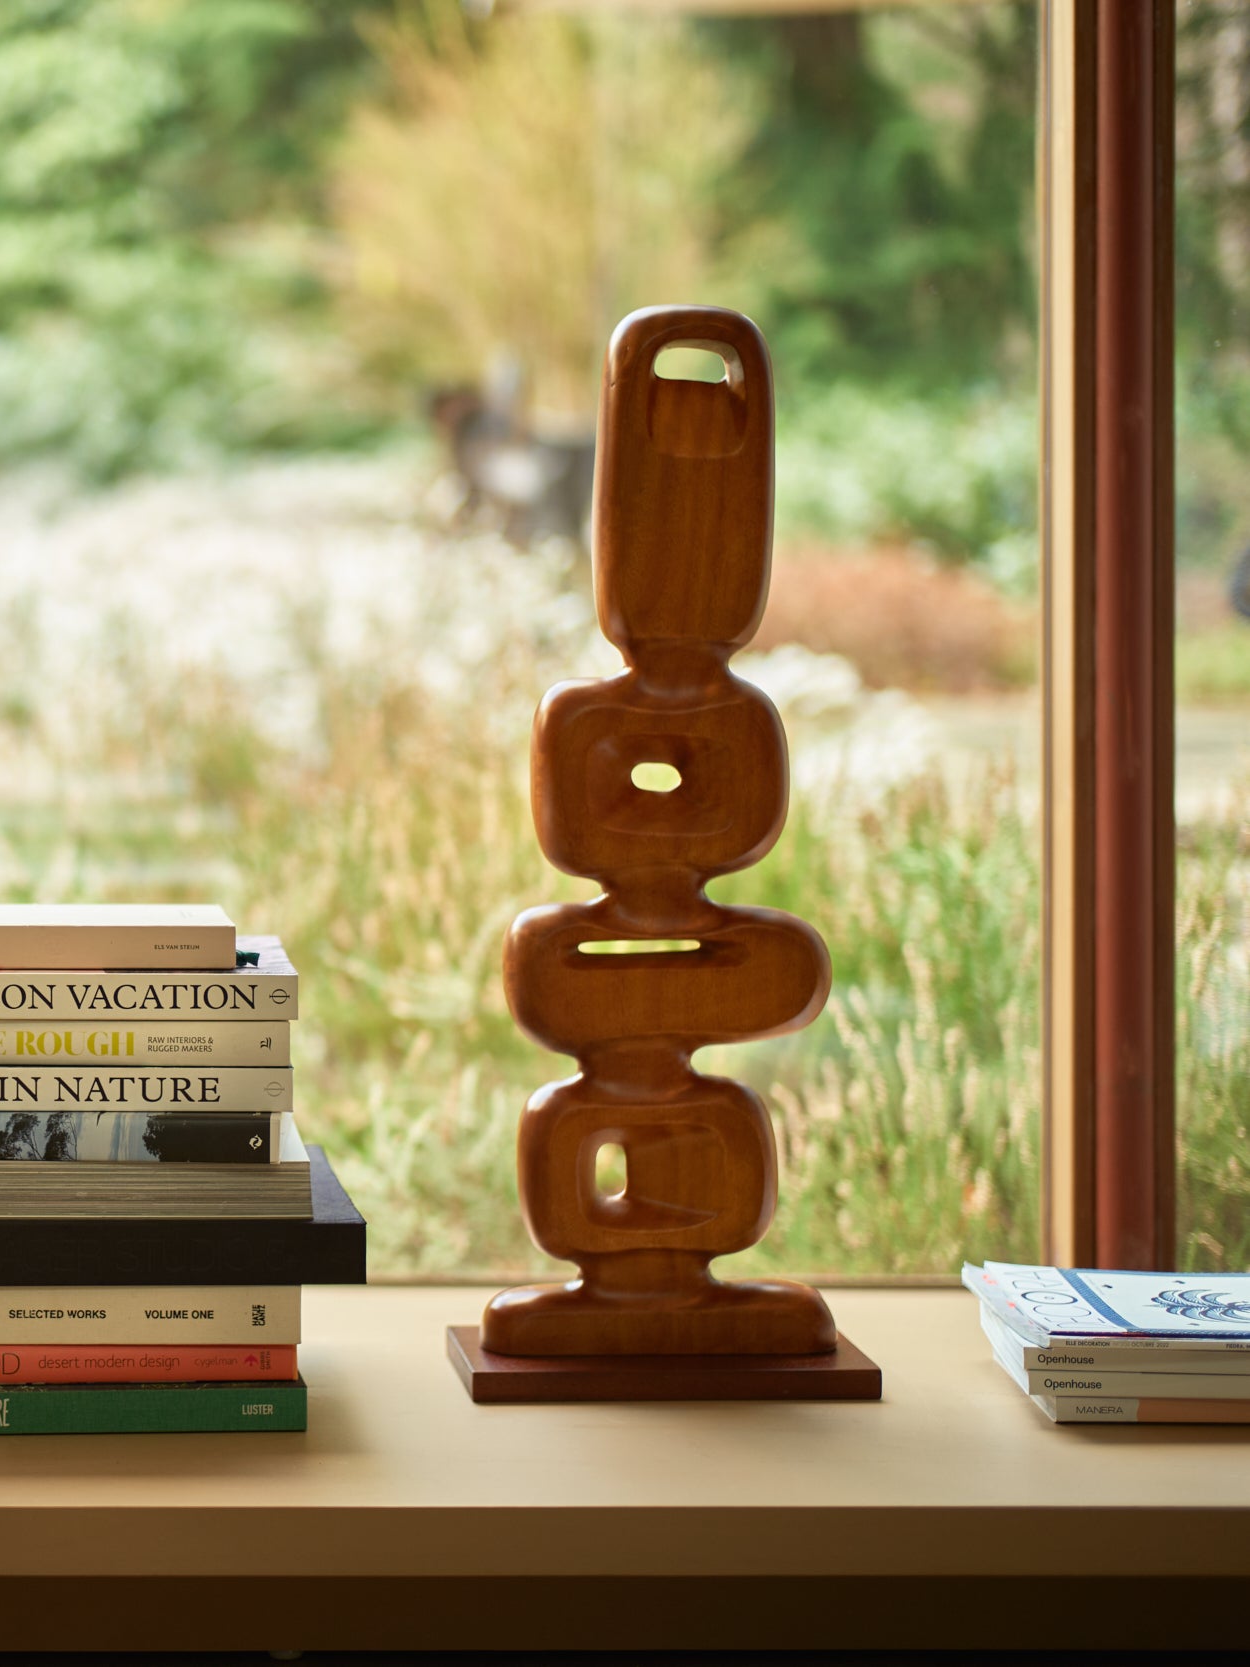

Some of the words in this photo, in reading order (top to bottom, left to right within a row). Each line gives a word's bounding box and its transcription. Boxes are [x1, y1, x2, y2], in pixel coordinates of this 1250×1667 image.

[1, 984, 56, 1010] ON
[66, 984, 258, 1010] VACATION
[15, 1031, 135, 1056] ROUGH
[148, 1036, 165, 1044] RAW
[167, 1036, 206, 1044] INTERIORS
[208, 1036, 214, 1044] &
[148, 1045, 180, 1053] RUGGED
[182, 1045, 213, 1053] MAKERS
[54, 1077, 221, 1102] NATURE
[8, 1310, 64, 1319] SELECTED
[67, 1310, 107, 1319] WORKS
[145, 1310, 188, 1319] VOLUME
[191, 1310, 214, 1319] ONE
[38, 1355, 80, 1369] desert
[84, 1355, 135, 1368] modern
[139, 1354, 180, 1372] design
[194, 1357, 238, 1367] cygelman
[1037, 1353, 1094, 1365] Openhouse
[1044, 1378, 1102, 1390] Openhouse
[242, 1404, 273, 1415] LUSTER
[1076, 1406, 1123, 1414] MANERA
